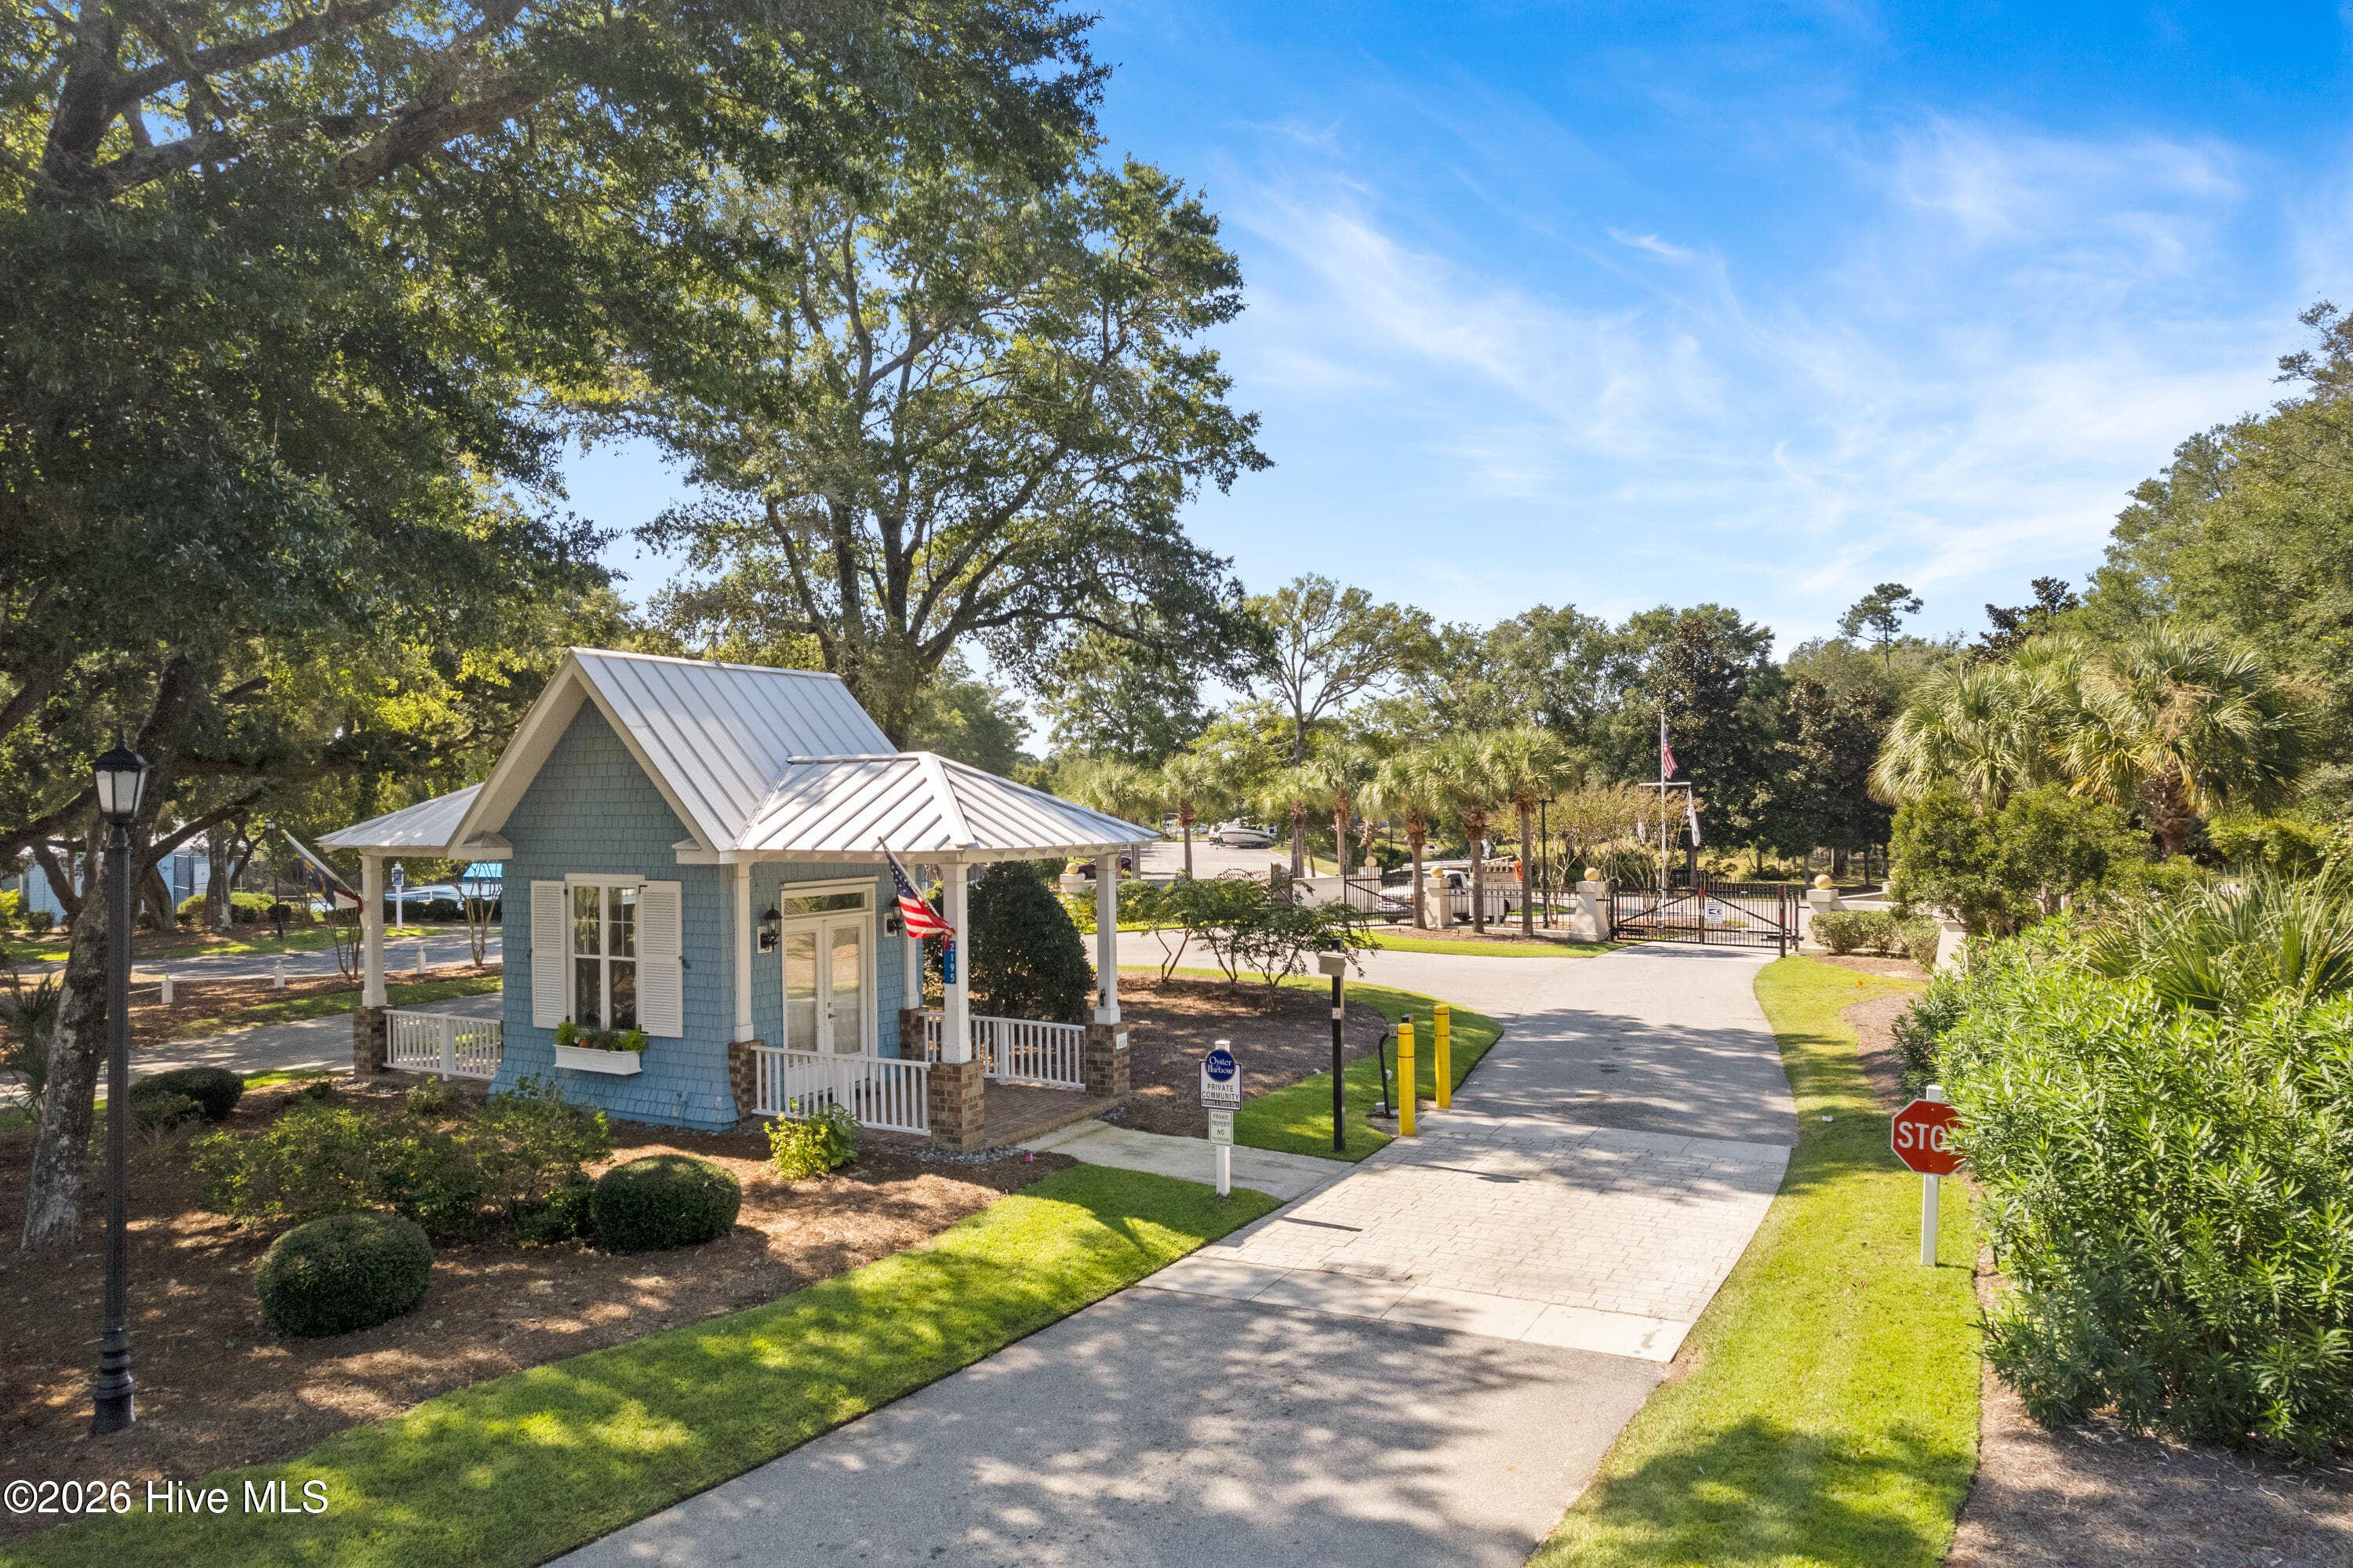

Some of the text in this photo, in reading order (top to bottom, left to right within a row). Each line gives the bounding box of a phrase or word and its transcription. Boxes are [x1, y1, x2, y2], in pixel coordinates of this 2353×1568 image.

[1209, 1056, 1232, 1068] Oyster
[1207, 1064, 1234, 1075] Harbour
[1207, 1083, 1234, 1093] PRIVATE
[1202, 1090, 1239, 1101] COMMUNITY
